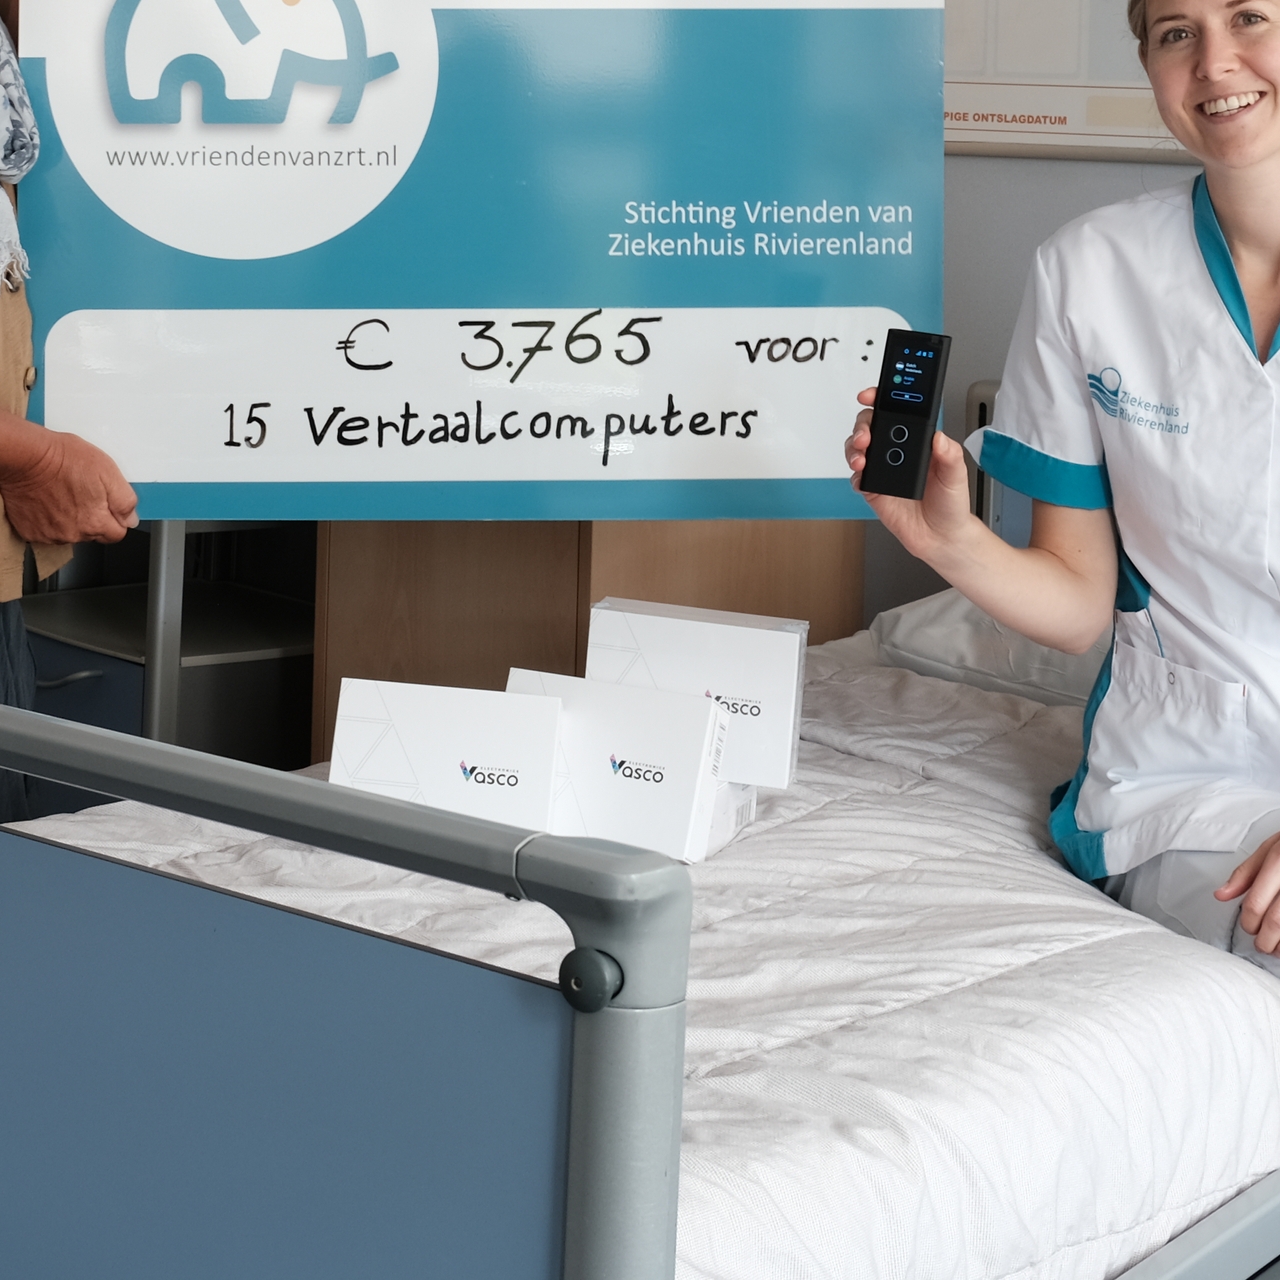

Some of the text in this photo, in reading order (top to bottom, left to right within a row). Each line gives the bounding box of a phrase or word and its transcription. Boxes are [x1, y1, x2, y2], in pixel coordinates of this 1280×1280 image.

[972, 112, 1067, 126] ONTSLAGDATUM
[106, 144, 399, 168] www.vriendenvanzrt.nl
[623, 200, 913, 230] Stichting Vrienden van
[607, 231, 913, 257] Ziekenhuis Rivierenland
[336, 319, 394, 370] €
[457, 308, 663, 384] 3.765
[736, 332, 840, 364] voor
[1119, 390, 1180, 418] Ziekenhuis
[223, 394, 759, 466] 15 Vertaalcomputers
[1118, 407, 1190, 435] Rivierenland
[459, 759, 519, 787] Vasco
[609, 753, 664, 784] Vasco
[628, 760, 665, 770] ELECTRONICS
